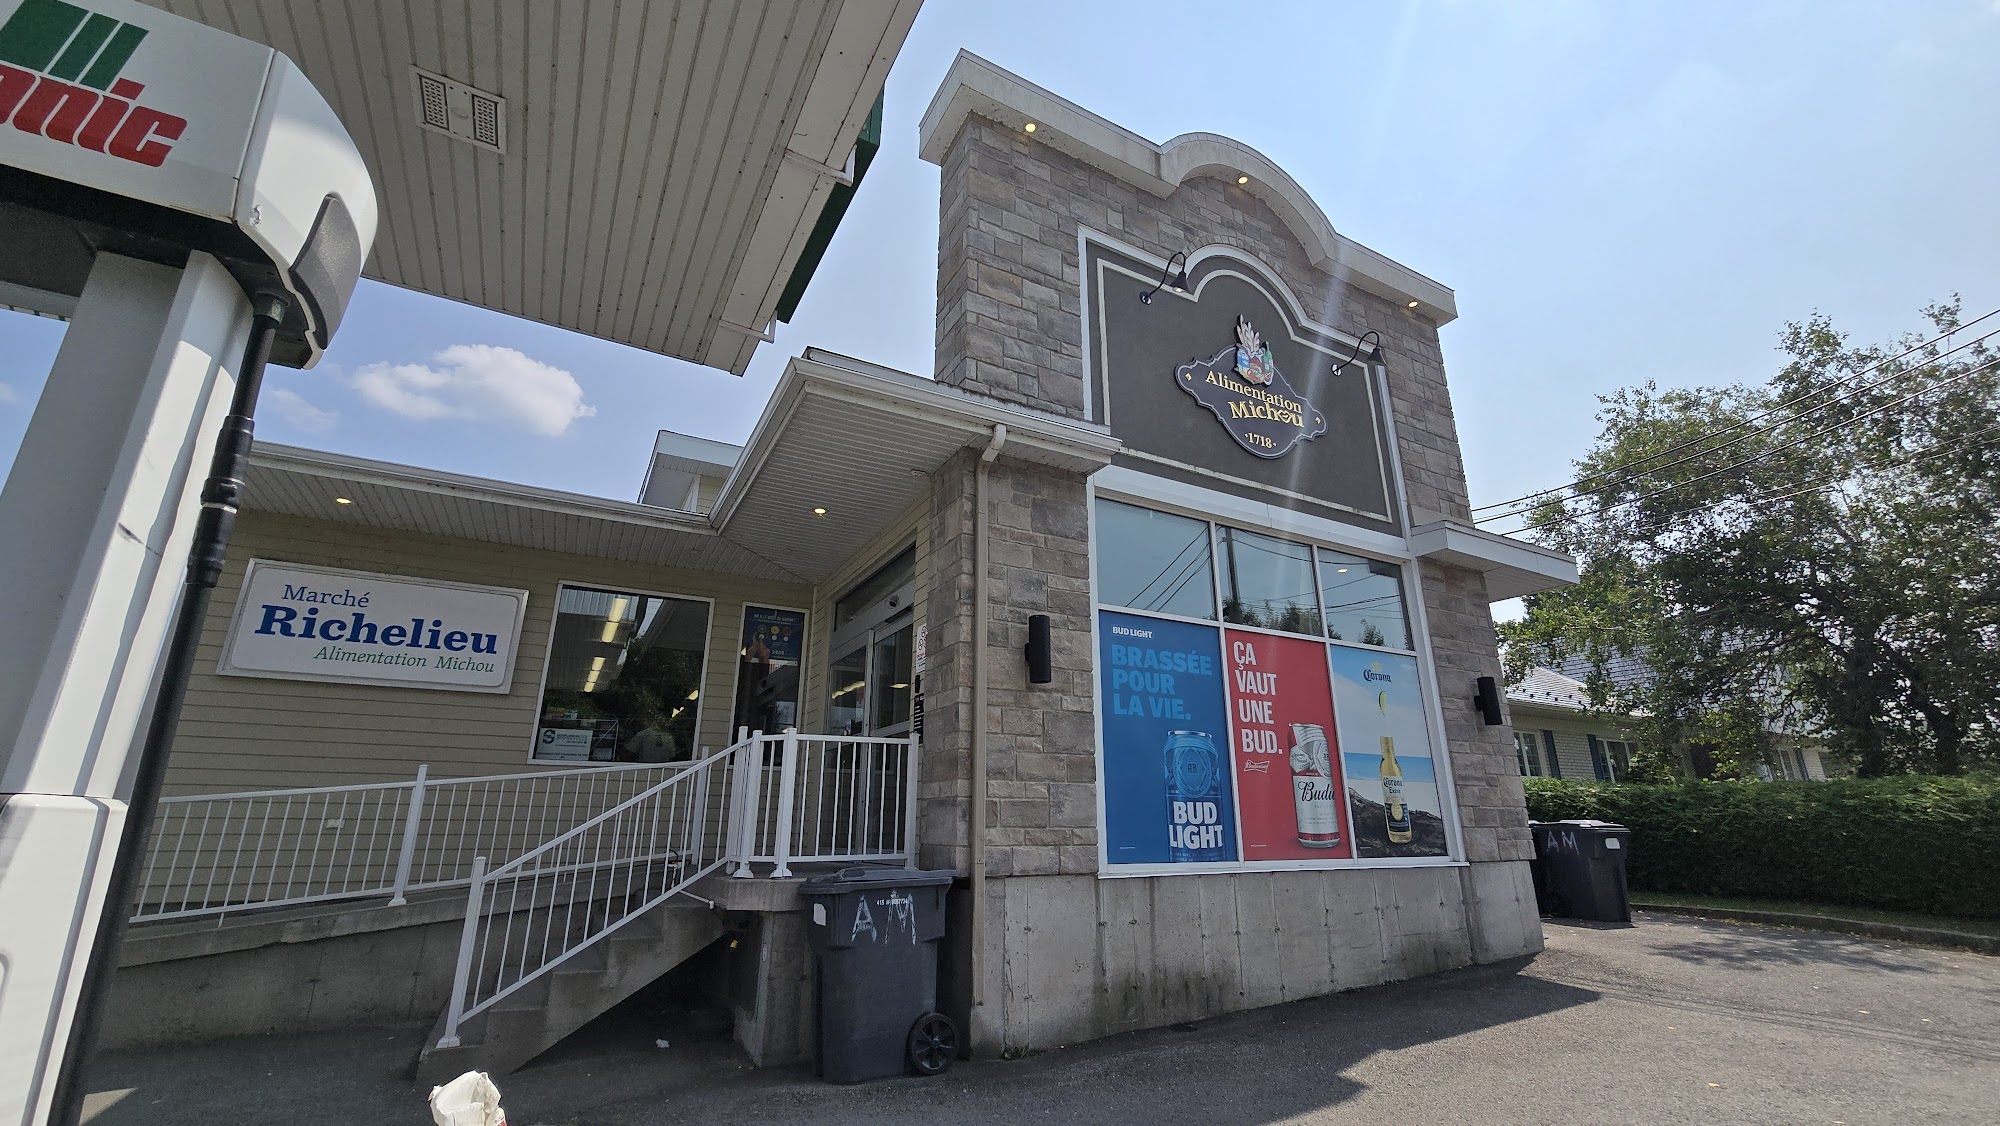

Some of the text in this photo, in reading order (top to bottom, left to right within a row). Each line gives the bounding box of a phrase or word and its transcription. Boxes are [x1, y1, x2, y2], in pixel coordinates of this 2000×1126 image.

[1205, 370, 1302, 414] Alimentation
[1228, 400, 1305, 427] Michou
[1247, 432, 1272, 449] 1718
[282, 584, 371, 608] Marché
[255, 604, 498, 654] Richelieu
[1112, 626, 1153, 639] BUD LIGHT
[313, 646, 495, 673] Alimentation Michou
[1111, 644, 1213, 676] BRASSÉE
[1233, 641, 1257, 670] ÇA
[1112, 668, 1176, 695] POUR
[1234, 669, 1277, 696] VAUT
[1363, 668, 1393, 684] Corona
[1113, 693, 1192, 721] LA VIE.
[1238, 698, 1275, 725] UNE
[1241, 728, 1283, 754] BUD.
[1173, 801, 1218, 825] BUD
[1168, 824, 1224, 849] LIGHT
